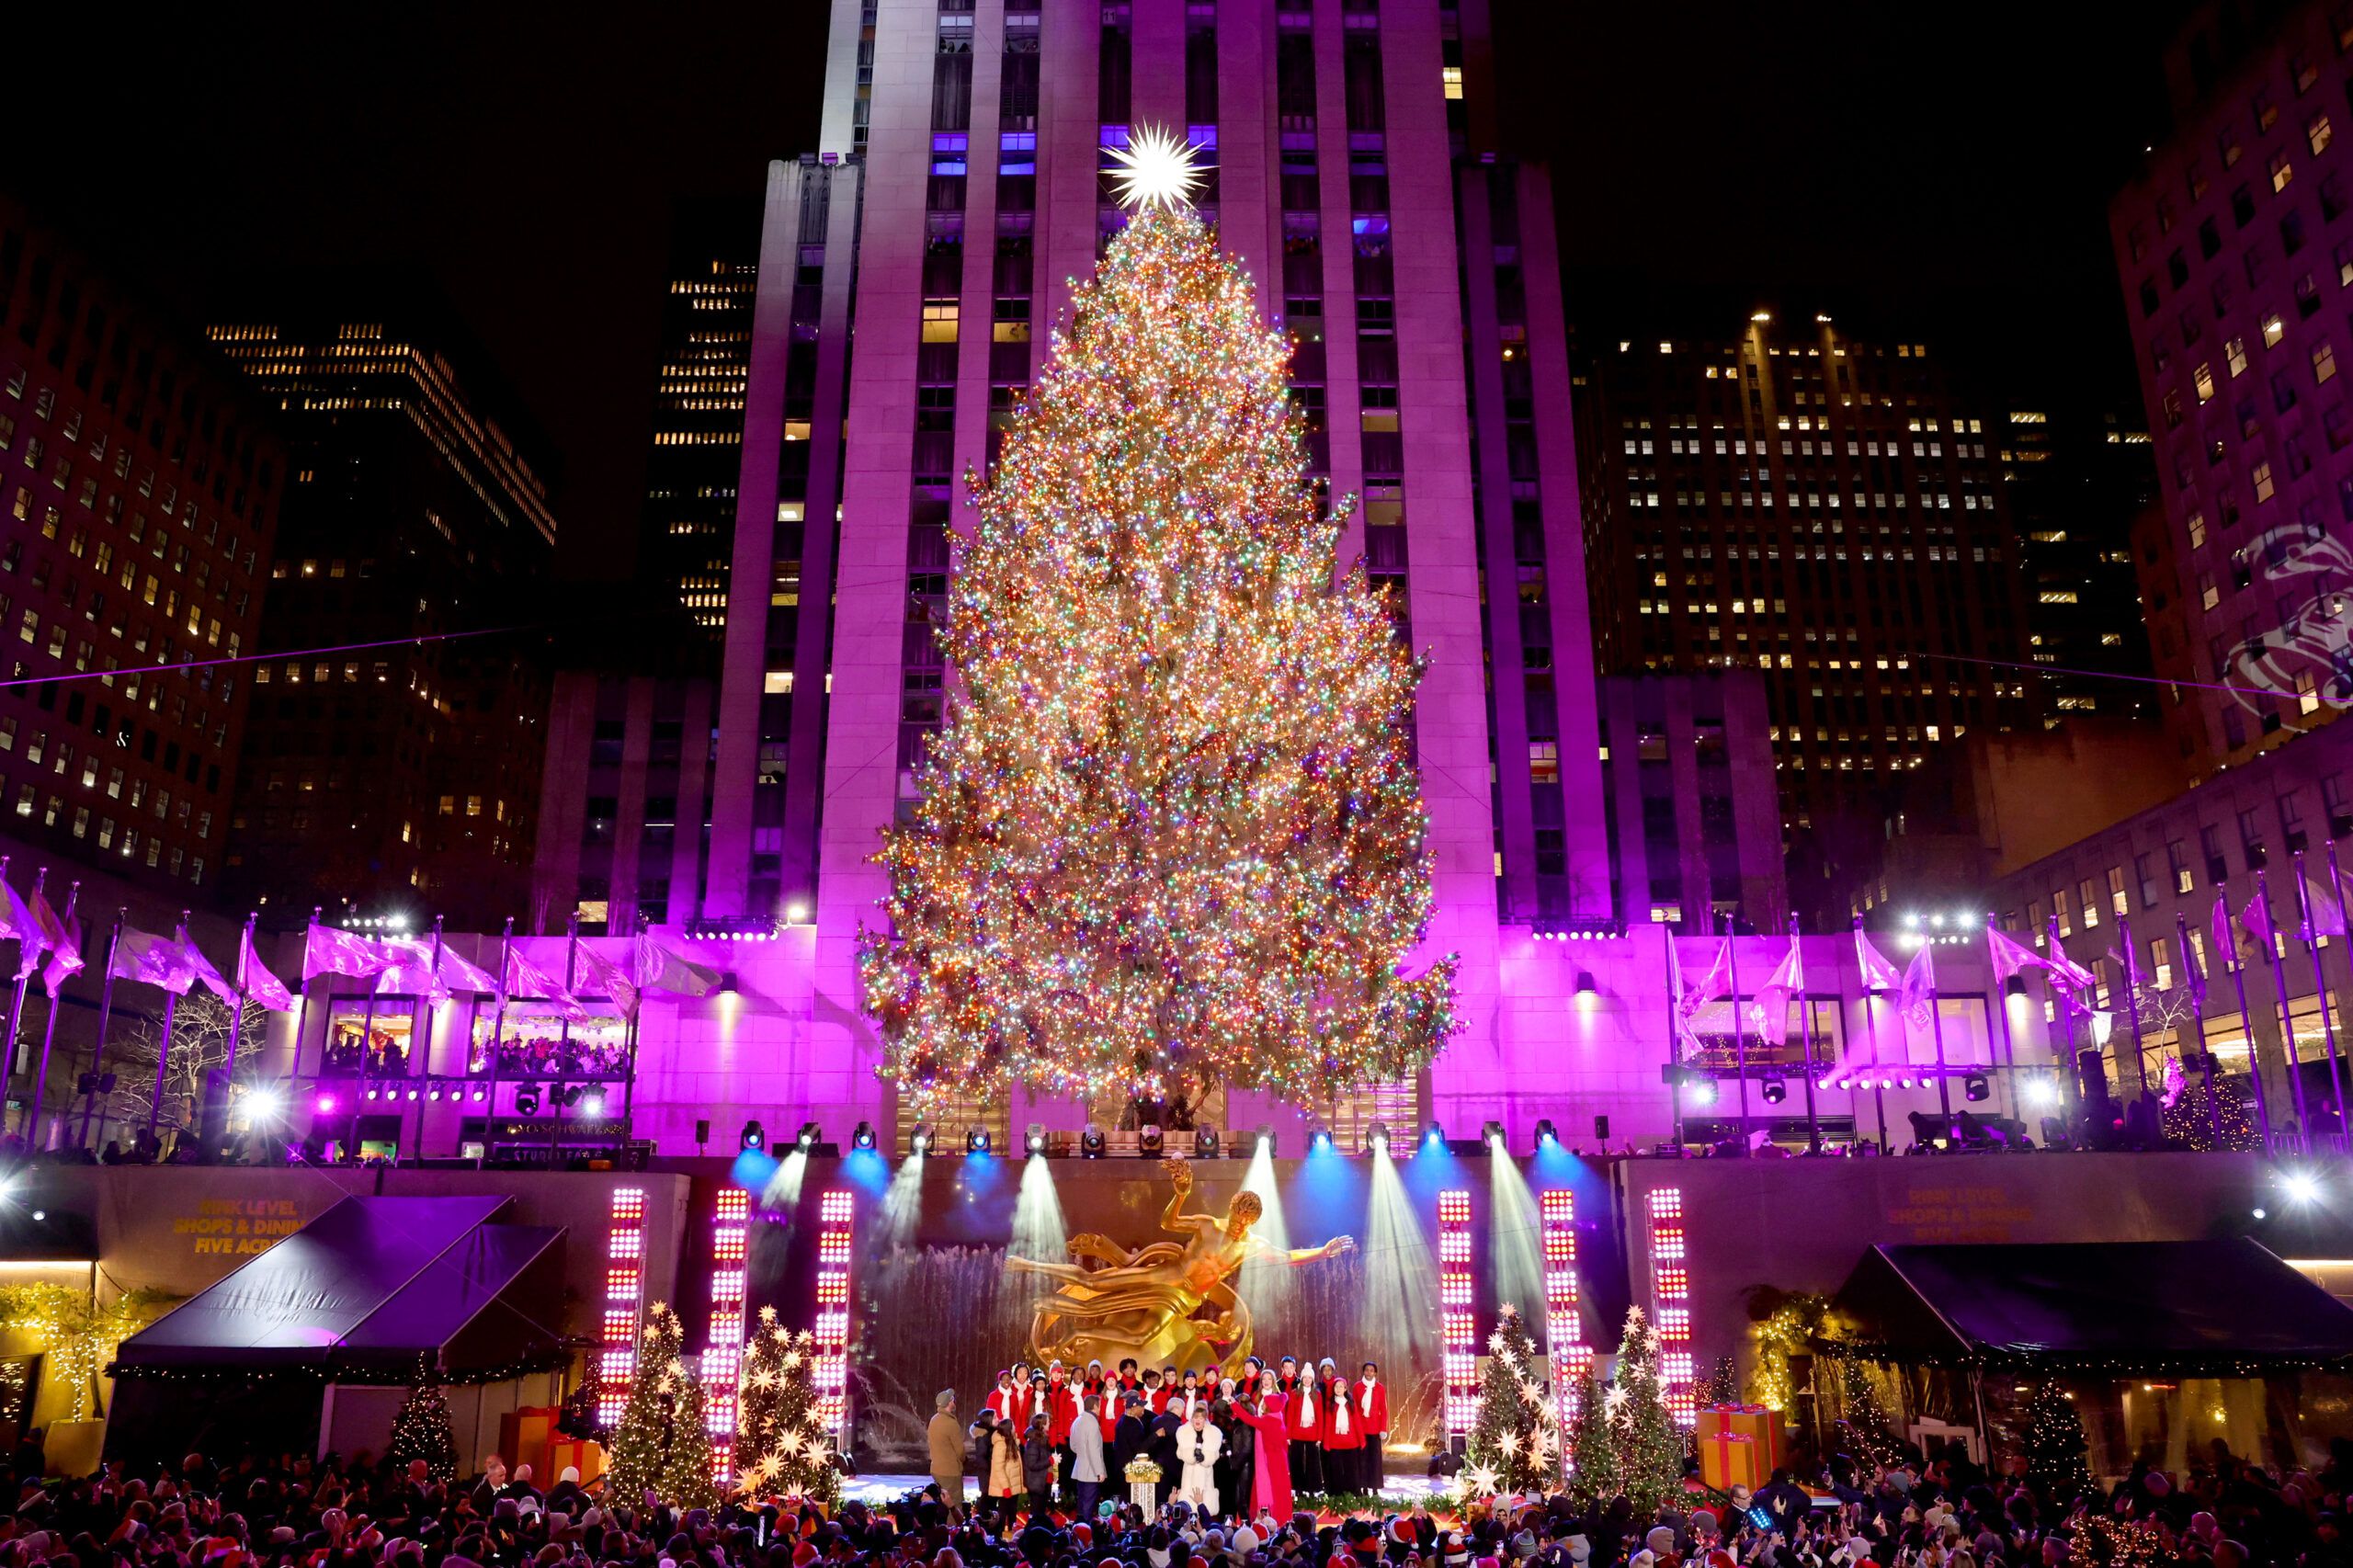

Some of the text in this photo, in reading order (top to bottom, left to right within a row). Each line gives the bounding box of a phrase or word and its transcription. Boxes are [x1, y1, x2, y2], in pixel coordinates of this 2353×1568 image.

[514, 1150, 560, 1162] STUDI
[247, 1199, 297, 1215] LEVEL
[175, 1219, 306, 1234] SHOPS & DININ
[195, 1238, 233, 1253] FIVE
